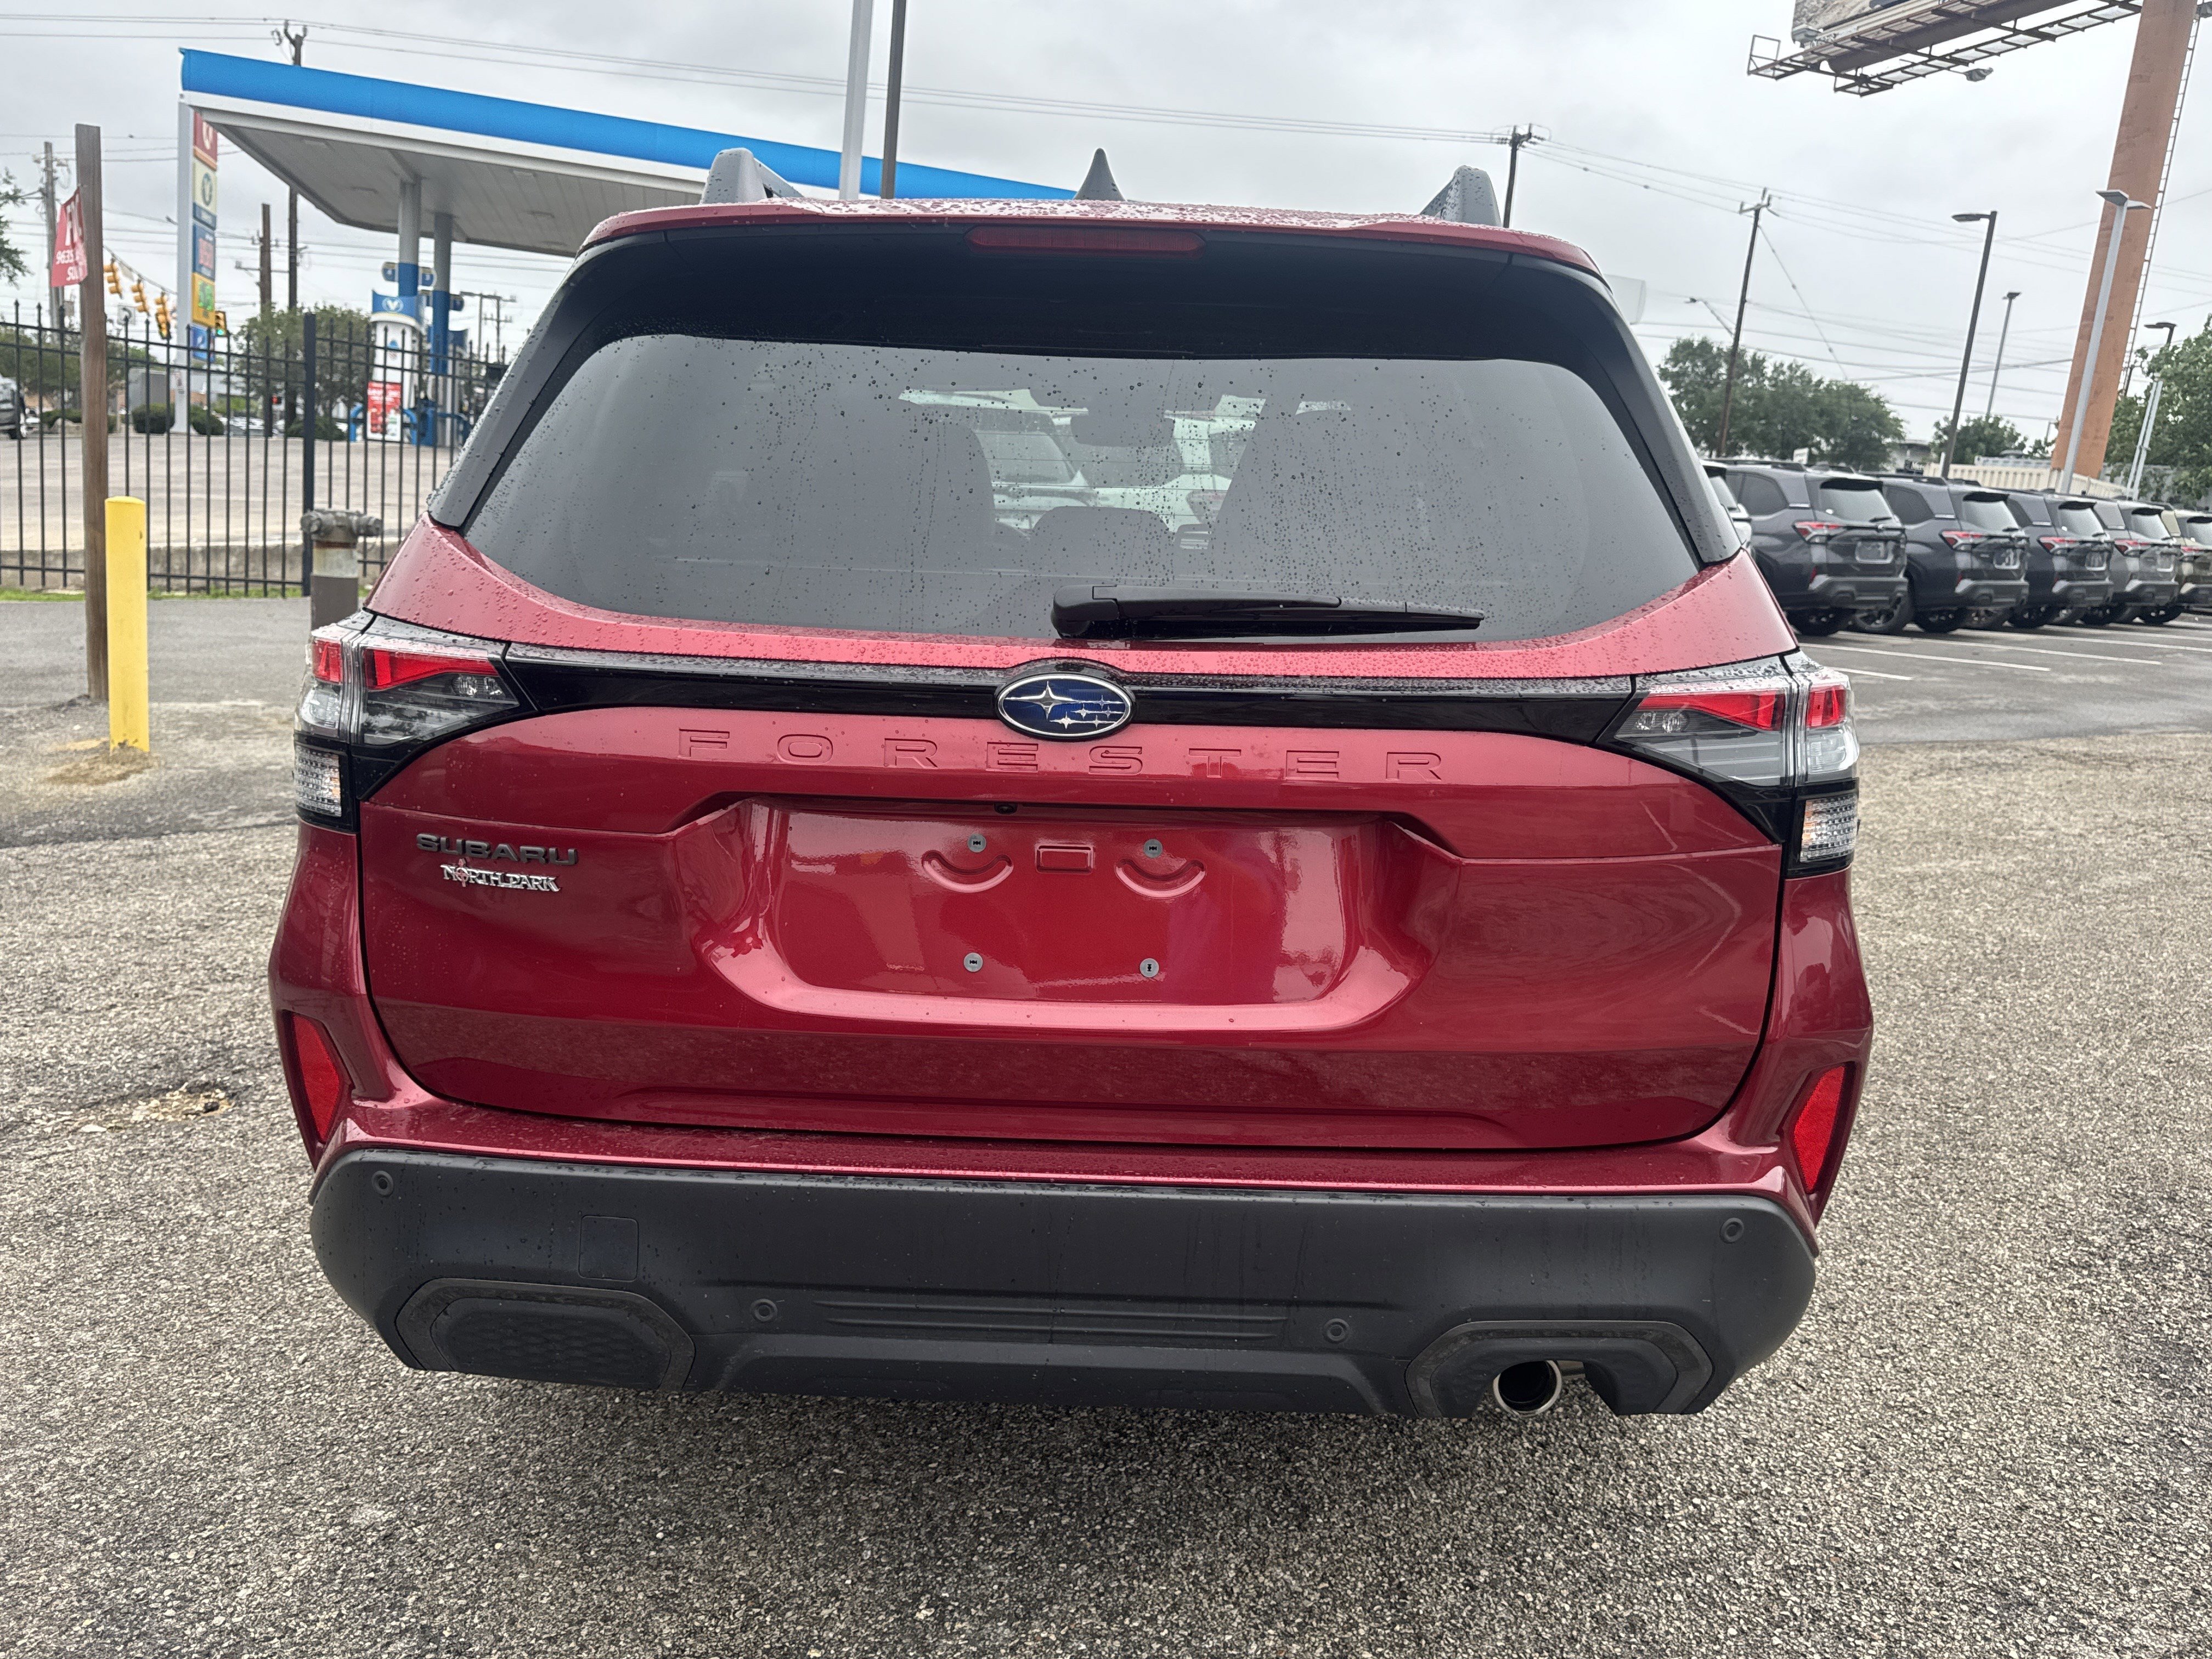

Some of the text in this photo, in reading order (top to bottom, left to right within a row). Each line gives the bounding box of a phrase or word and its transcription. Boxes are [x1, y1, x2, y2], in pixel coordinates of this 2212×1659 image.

[678, 729, 1442, 781] FORESTER
[416, 833, 579, 866] SUBARU
[440, 864, 561, 892] NORTH PARK
